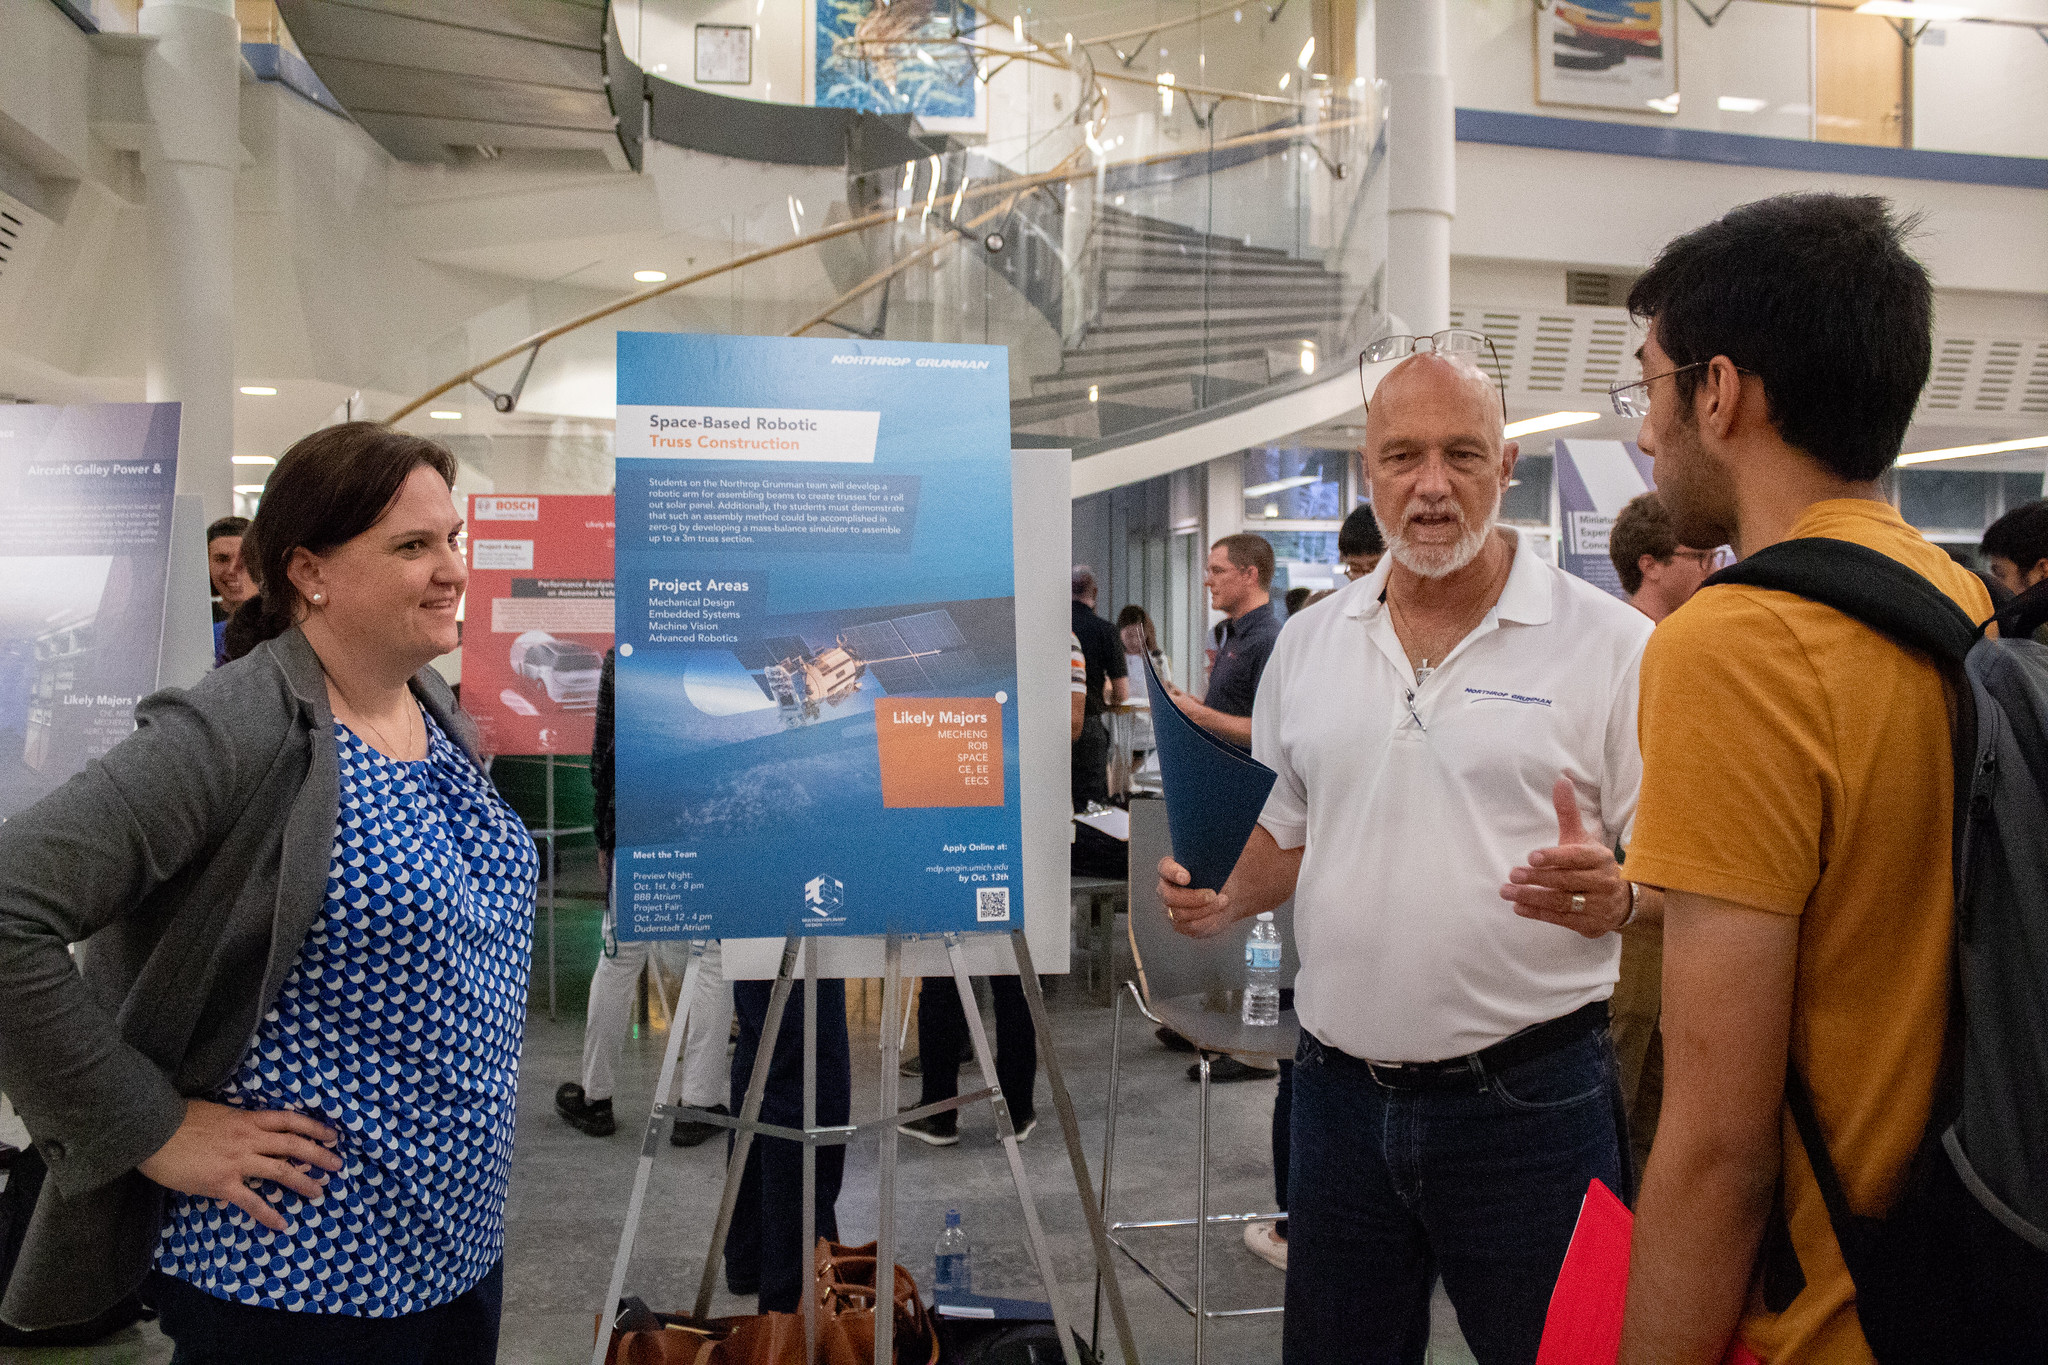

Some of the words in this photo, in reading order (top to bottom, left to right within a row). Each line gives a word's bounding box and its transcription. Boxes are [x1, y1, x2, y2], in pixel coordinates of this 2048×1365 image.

[831, 355, 911, 367] NORTHROP
[915, 357, 990, 370] GRUMMAN
[650, 414, 751, 431] Space-Based
[756, 417, 818, 432] Robotic
[650, 434, 692, 449] Truss
[698, 435, 800, 451] Construction
[28, 464, 71, 476] Aircraft
[74, 463, 110, 477] Galley
[113, 464, 150, 475] Power
[153, 463, 162, 474] &
[649, 478, 688, 487] Students
[703, 479, 718, 488] the
[720, 479, 760, 490] Northrop
[762, 480, 804, 489] Grumman
[806, 482, 828, 490] team
[830, 481, 844, 490] will
[846, 481, 880, 492] develop
[649, 489, 680, 498] robotic
[702, 490, 714, 498] for
[716, 491, 764, 501] assembling
[766, 491, 795, 500] beams
[837, 493, 867, 501] trusses
[869, 493, 881, 501] for
[496, 501, 536, 511] BOSCH
[649, 501, 663, 509] out
[666, 501, 686, 509] solar
[689, 502, 715, 511] panel.
[717, 502, 771, 512] Additionally,
[773, 503, 788, 511] the
[789, 503, 826, 511] students
[851, 505, 905, 513] demonstrate
[649, 512, 667, 520] that
[669, 512, 688, 520] such
[703, 512, 743, 522] assembly
[820, 515, 877, 524] accomplished
[649, 524, 677, 533] zero-g
[679, 524, 690, 533] by
[692, 524, 741, 534] developing
[750, 525, 807, 533] mass-balance
[809, 525, 848, 534] simulator
[862, 526, 901, 535] assemble
[649, 535, 660, 544] up
[662, 535, 672, 543] to
[682, 534, 696, 543] 3m
[698, 535, 718, 543] truss
[649, 579, 702, 594] Project
[706, 579, 749, 592] Areas
[649, 598, 701, 607] Mechanical
[703, 598, 735, 609] Design
[649, 610, 700, 619] Embedded
[703, 610, 741, 620] Systems
[649, 622, 688, 630] Machine
[691, 622, 718, 630] Vision
[649, 633, 695, 642] Advanced
[698, 633, 738, 643] Robotics
[64, 695, 94, 707] Likely
[96, 695, 132, 707] Majors
[1464, 687, 1508, 697] NORTHROP
[1511, 694, 1552, 705] GRUMMAN
[893, 711, 935, 727] Likely
[939, 711, 988, 727] Majors
[938, 730, 988, 739] MECHENG
[968, 741, 988, 750] ROB
[957, 753, 989, 762] SPACE
[958, 765, 974, 774] CE,
[976, 765, 989, 774] EE
[965, 776, 989, 785] EECS
[943, 844, 967, 854] Apply
[969, 843, 995, 851] Online
[997, 843, 1008, 851] at:
[658, 851, 672, 859] the
[926, 863, 1009, 874] mdp.engin.umich.edu
[633, 872, 666, 880] Preview
[668, 872, 693, 881] Night:
[958, 874, 969, 883] by
[971, 873, 988, 881] Oct.
[991, 873, 1009, 881] 13th
[634, 883, 651, 891] Oct.
[654, 883, 669, 891] 1st,
[690, 882, 704, 891] pm
[634, 893, 651, 901] BBB
[653, 893, 681, 901] Atrium
[634, 903, 663, 913] Project
[665, 902, 683, 911] Fair:
[634, 914, 652, 922] Oct.
[654, 914, 672, 922] 2nd,
[699, 913, 713, 922] pm
[634, 923, 680, 933] Duderstadt
[682, 923, 711, 931] Atrium
